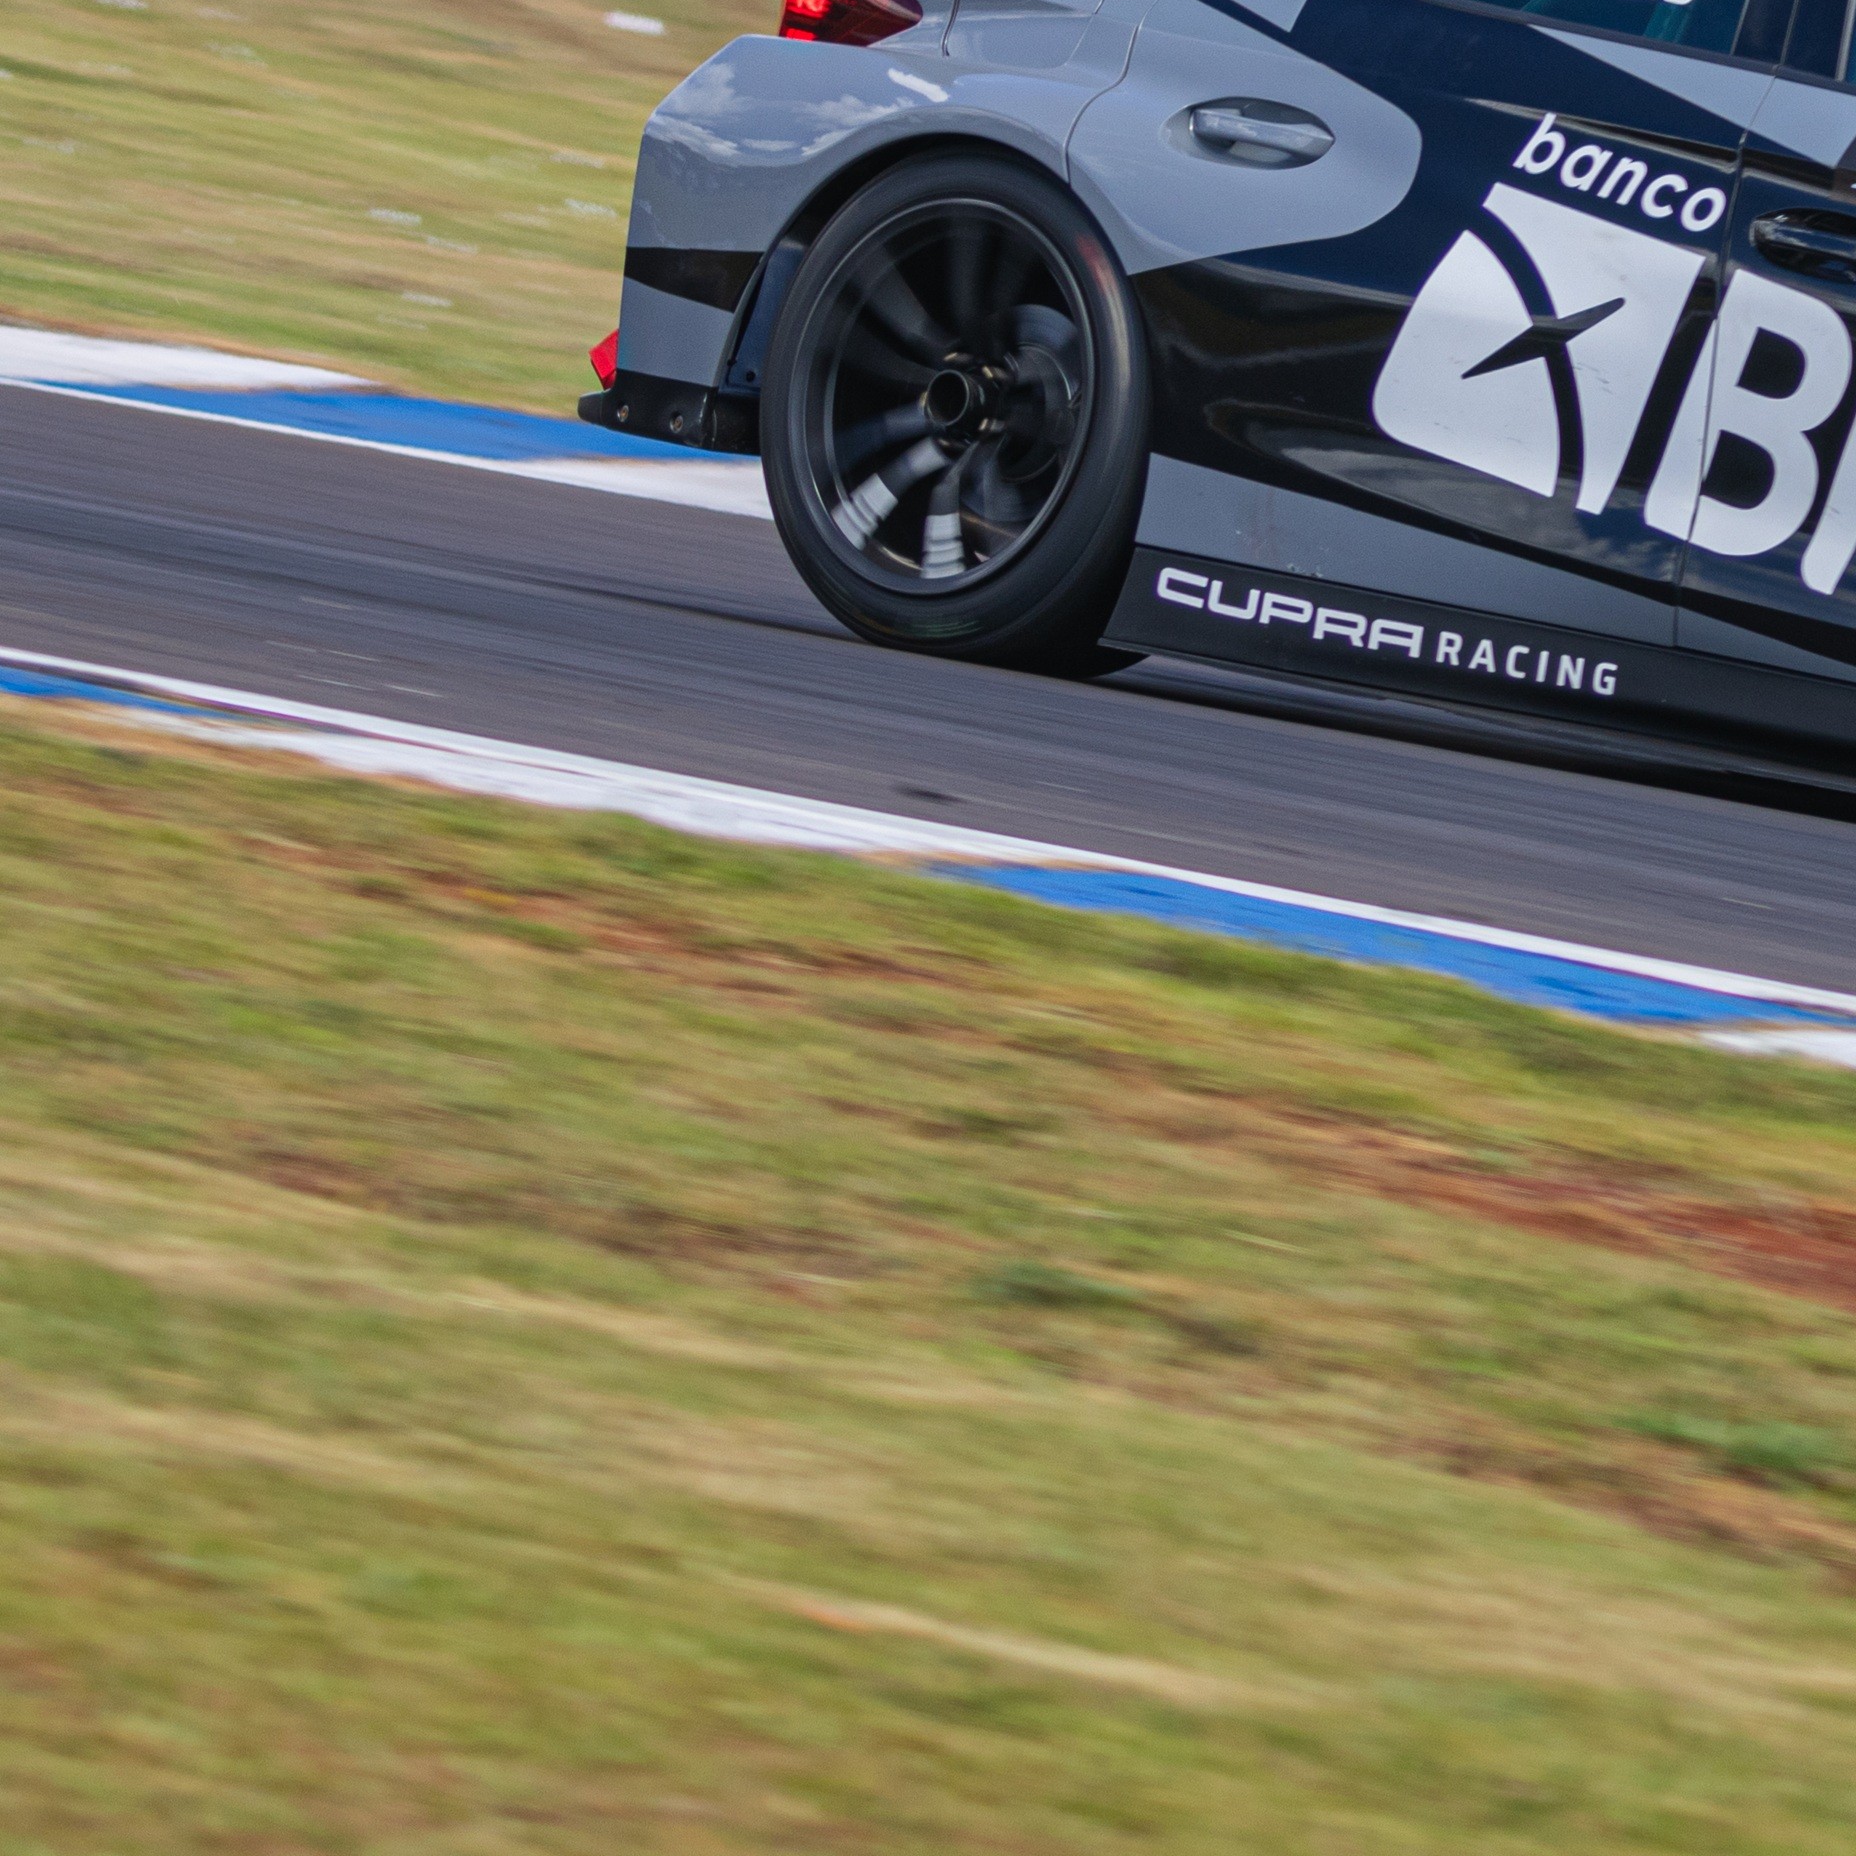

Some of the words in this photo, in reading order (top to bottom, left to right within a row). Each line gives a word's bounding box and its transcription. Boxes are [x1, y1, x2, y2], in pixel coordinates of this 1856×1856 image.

[1512, 112, 1727, 233] banco
[1156, 567, 1424, 658] CUPRA
[1436, 630, 1619, 696] RACING
